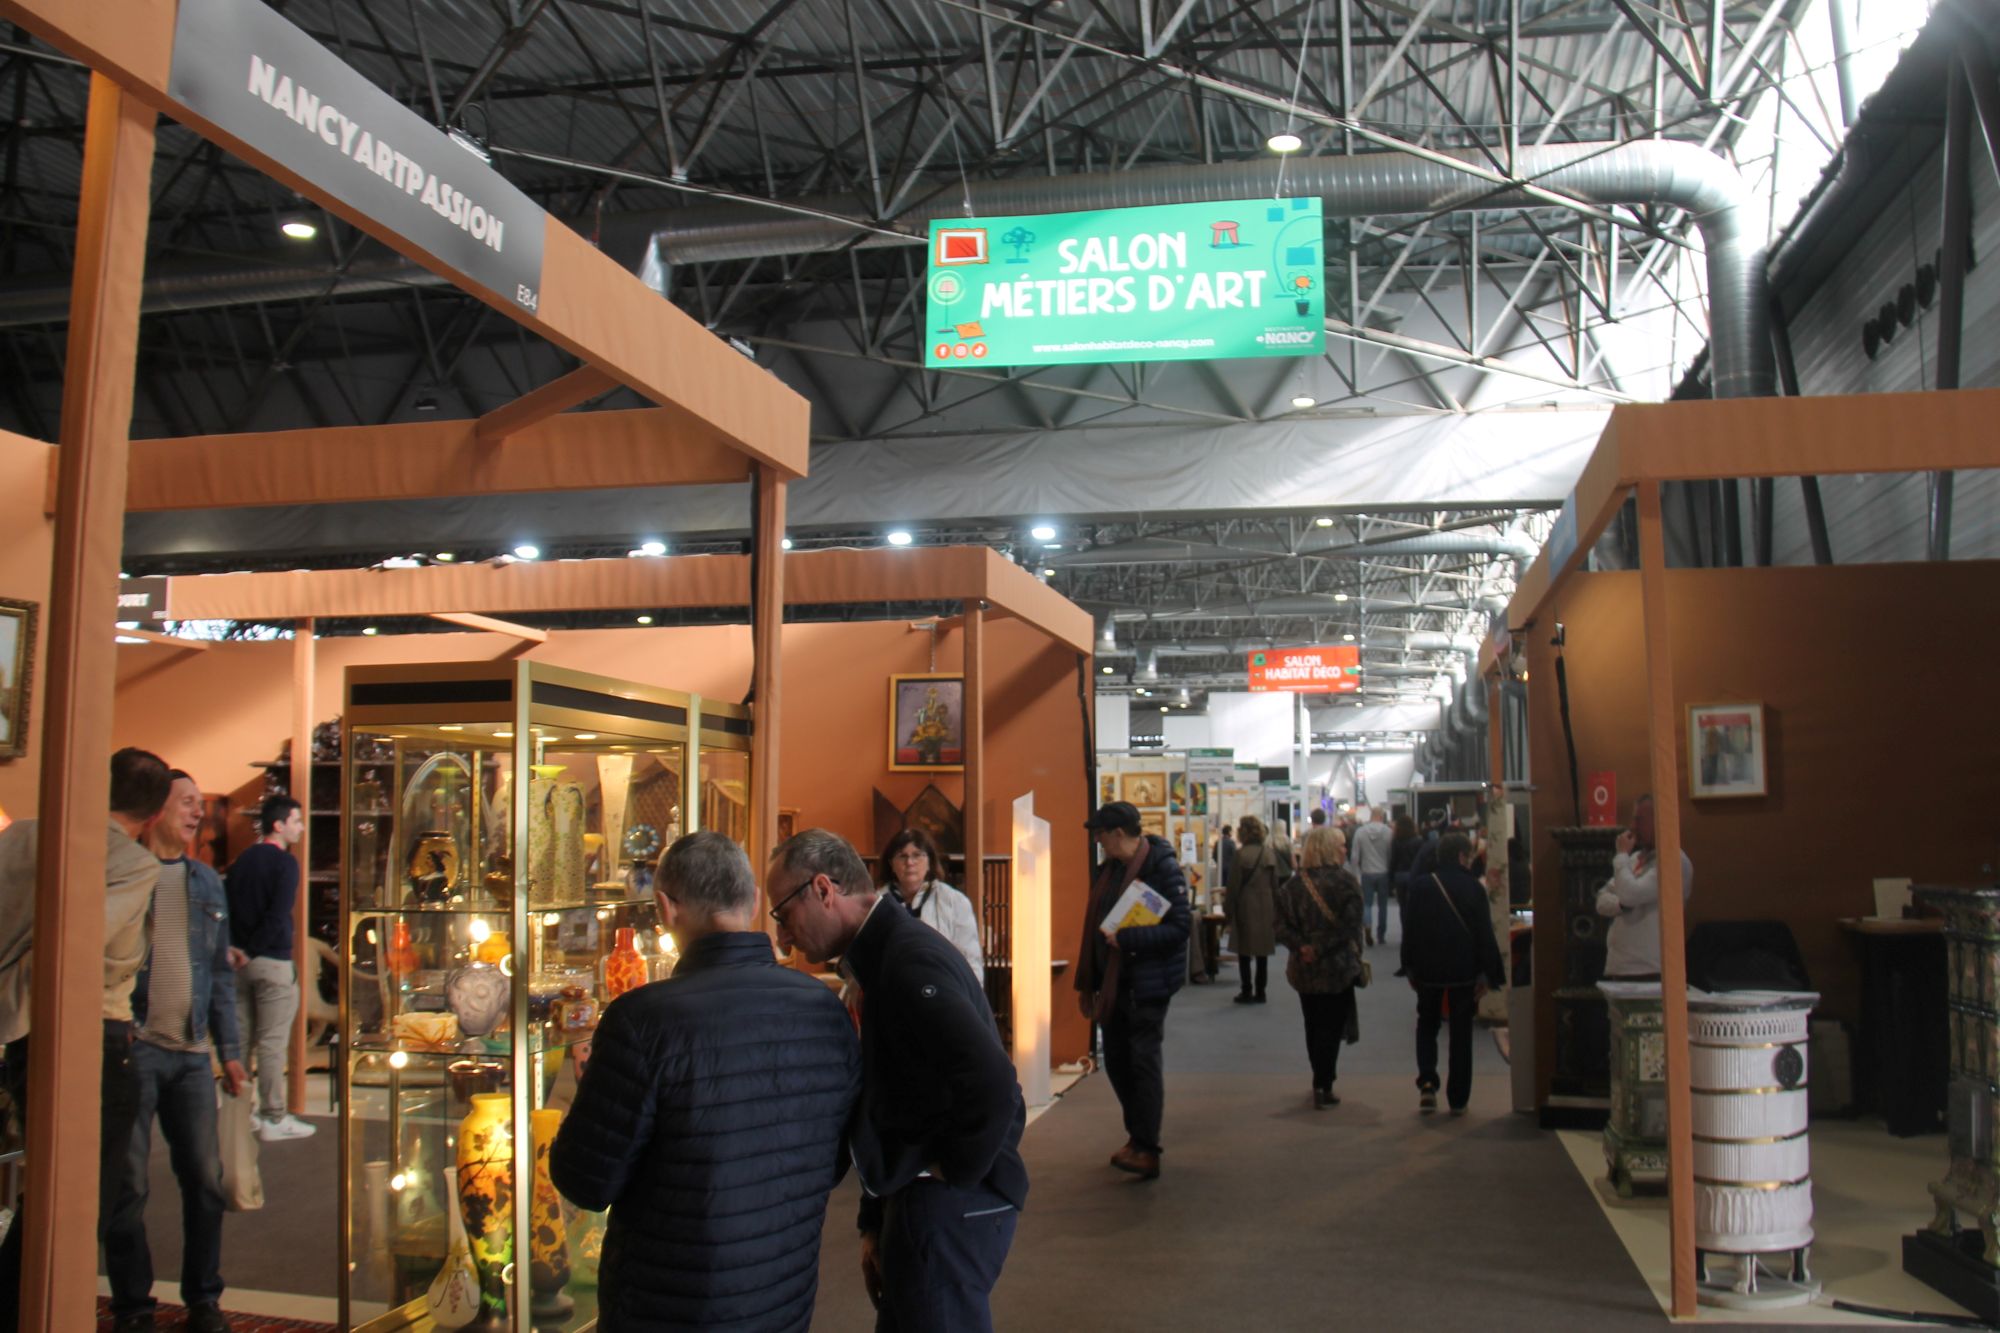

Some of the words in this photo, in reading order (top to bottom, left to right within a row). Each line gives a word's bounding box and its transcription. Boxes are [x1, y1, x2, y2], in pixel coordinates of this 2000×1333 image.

[1057, 232, 1187, 274] SALON
[516, 283, 538, 311] E84
[980, 273, 1137, 318] MÉTIERS
[1148, 270, 1267, 312] D'ART
[1265, 667, 1311, 680] HABITAT
[1284, 655, 1322, 667] SALON
